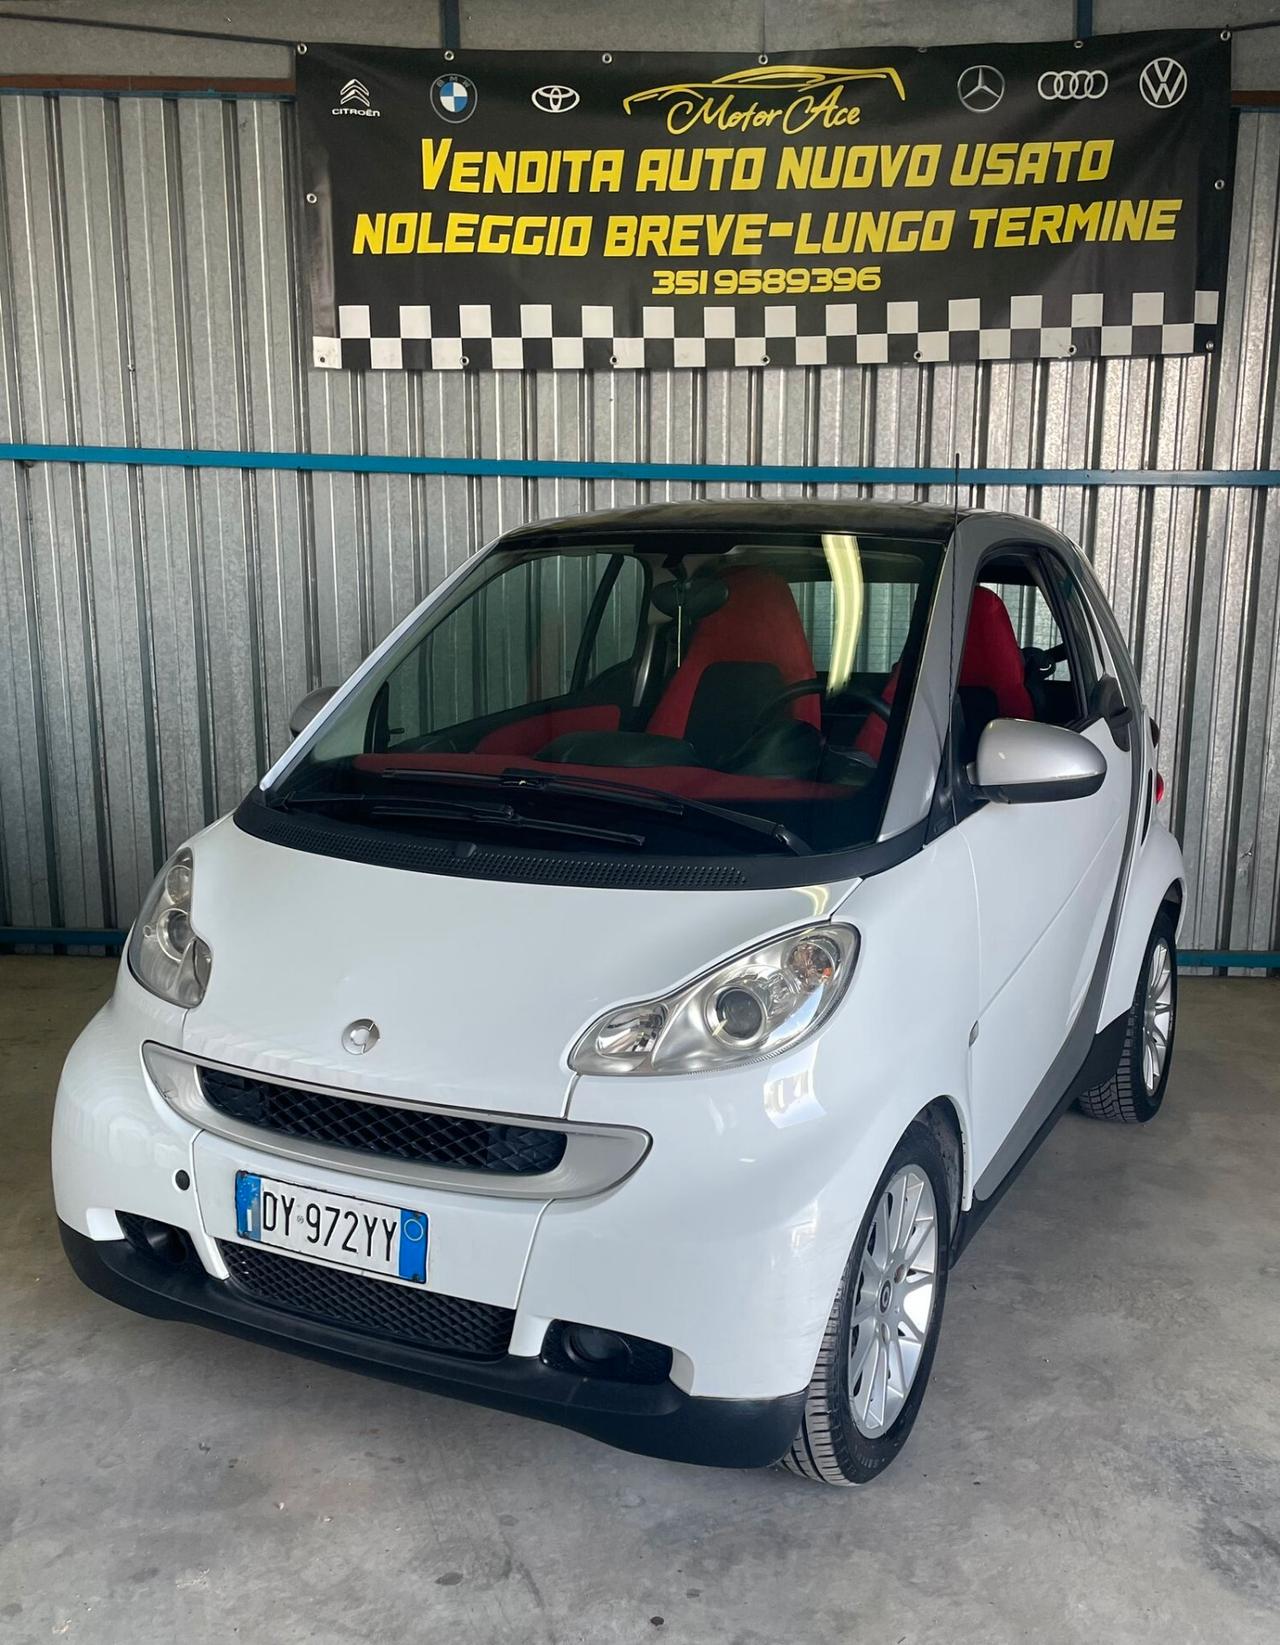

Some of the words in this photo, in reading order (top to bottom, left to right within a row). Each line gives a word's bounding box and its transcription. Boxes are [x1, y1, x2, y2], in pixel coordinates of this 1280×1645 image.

[666, 94, 783, 136] Motor
[783, 84, 861, 135] Ace
[635, 147, 767, 192] AUTO
[775, 143, 942, 190] NUOVO
[949, 139, 1115, 187] USATO
[352, 211, 593, 257] NOLEGGIO
[603, 209, 956, 257] BREVE-LUNGO
[969, 199, 1183, 249] TERMINE
